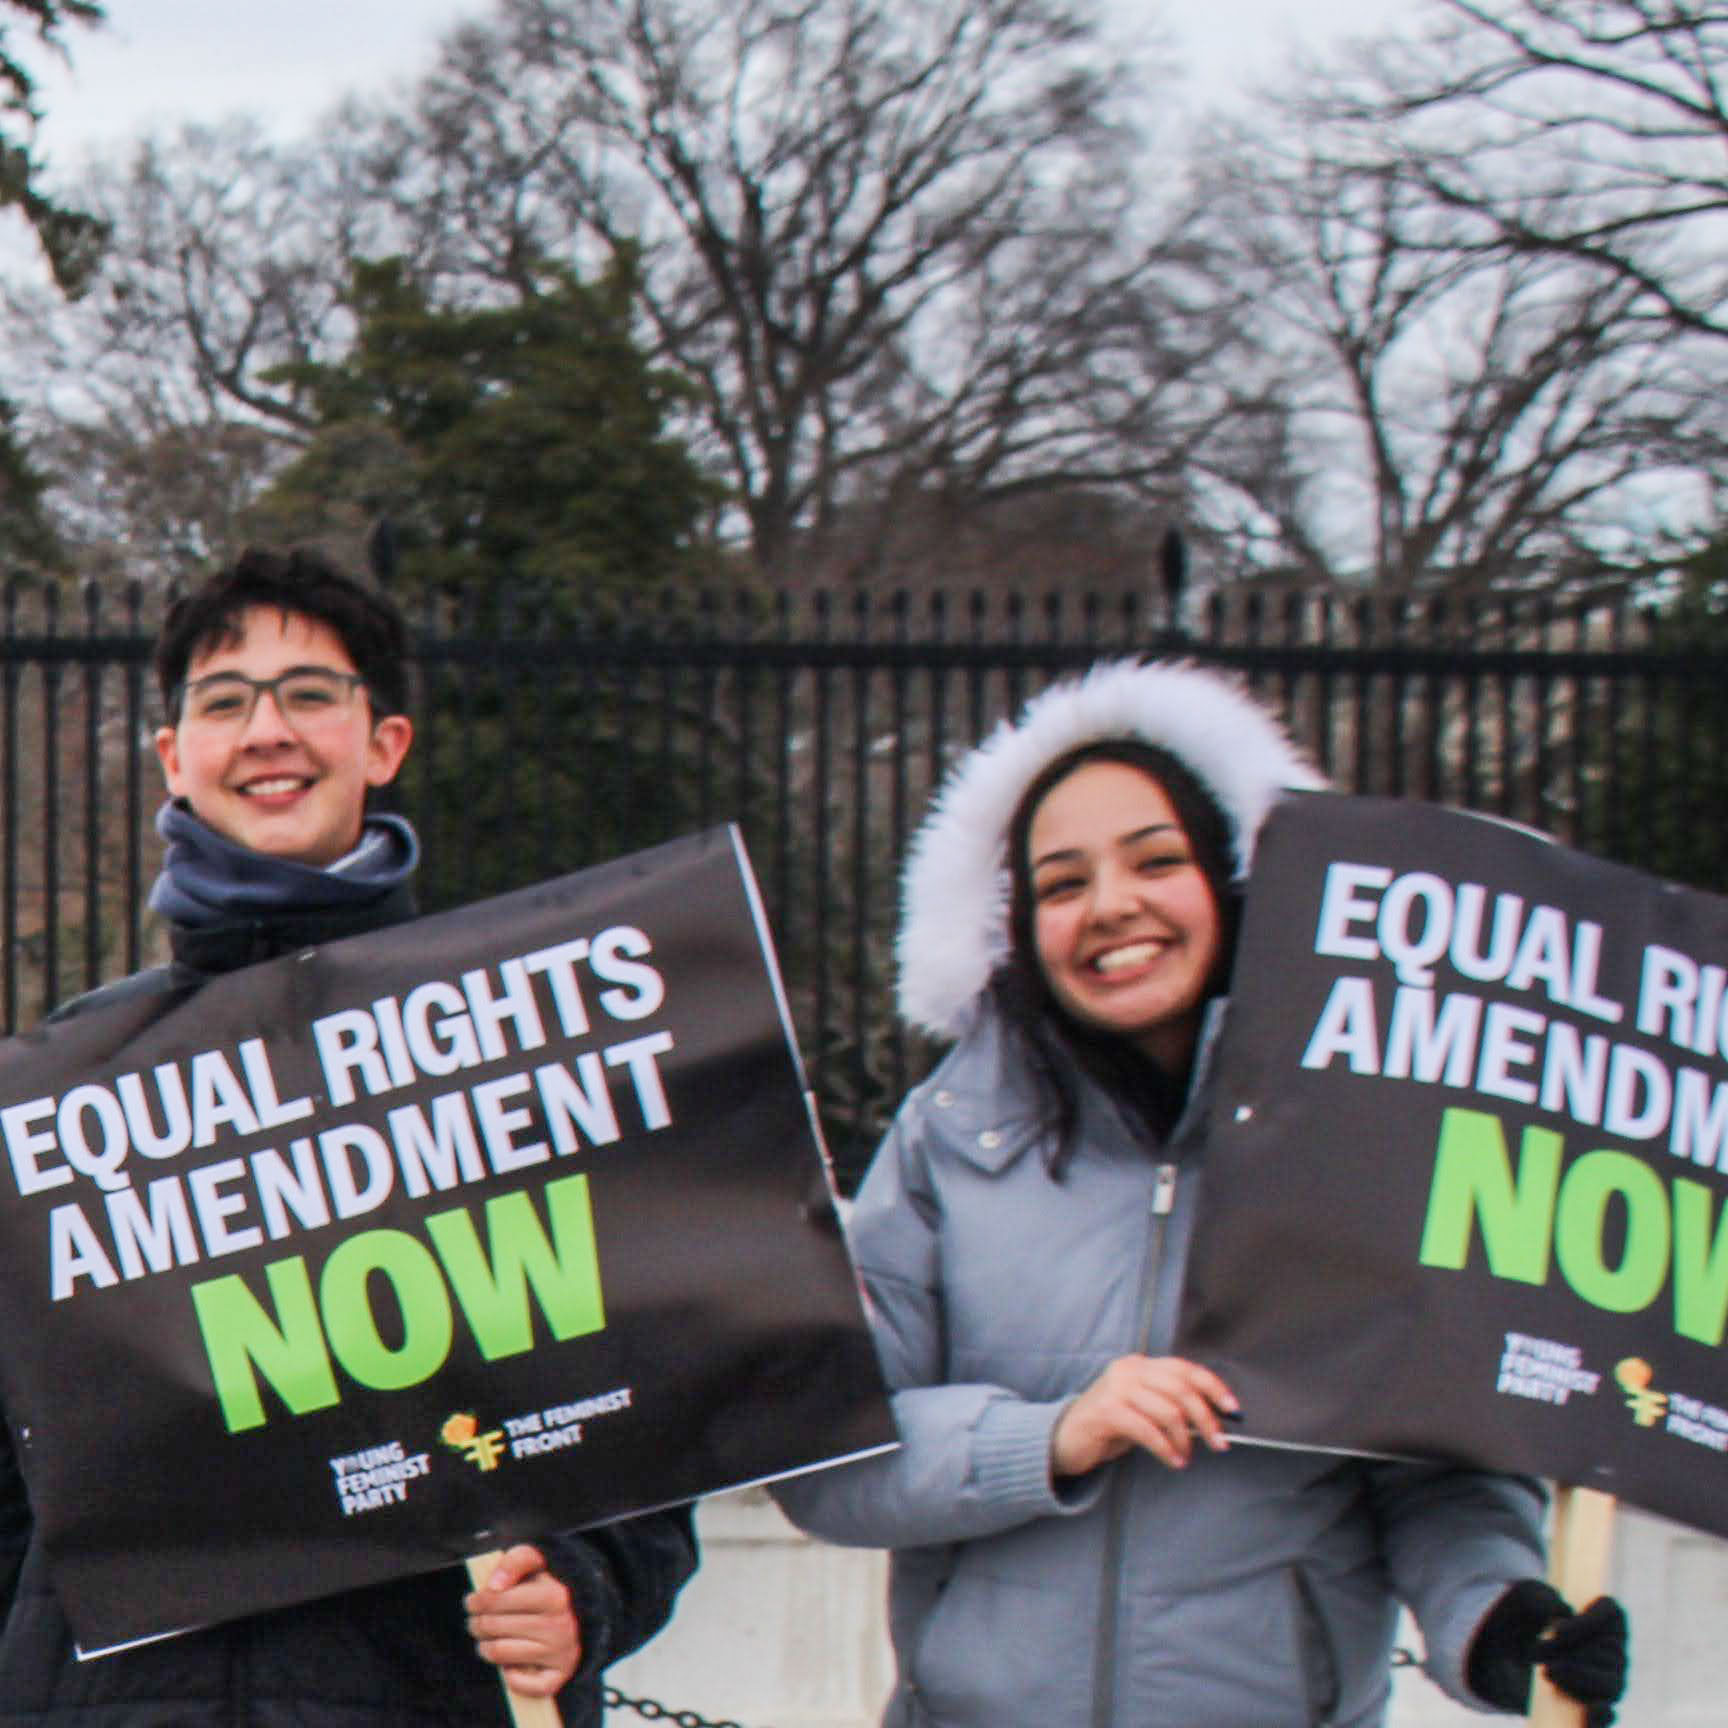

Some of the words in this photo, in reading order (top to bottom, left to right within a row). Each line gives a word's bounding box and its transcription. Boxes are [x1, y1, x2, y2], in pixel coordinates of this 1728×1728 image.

[0, 1037, 312, 1197] EQUAL
[313, 925, 666, 1108] RIGHTS
[1313, 860, 1624, 1024] EQUAL
[1636, 942, 1728, 1062] RI
[50, 1030, 673, 1300] AMENDMENT
[190, 1173, 606, 1434] NOW
[342, 1480, 408, 1516] PARTY
[503, 1412, 544, 1437] THE
[511, 1423, 584, 1459] FRONT
